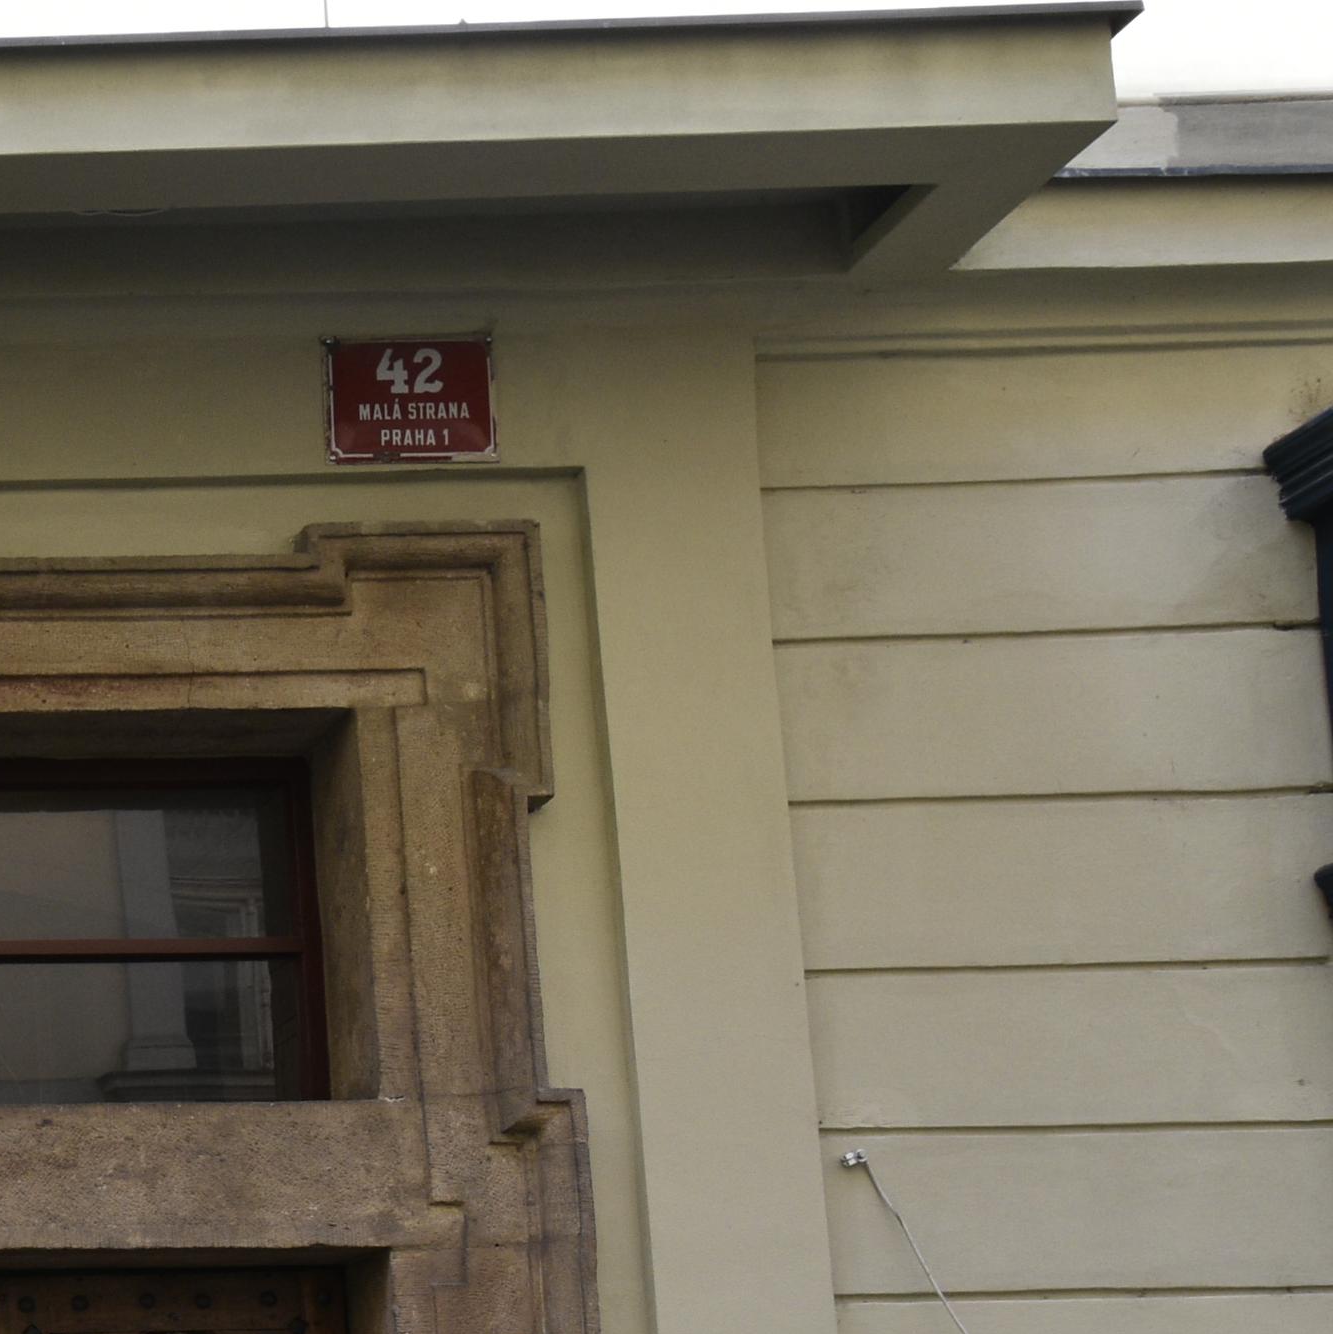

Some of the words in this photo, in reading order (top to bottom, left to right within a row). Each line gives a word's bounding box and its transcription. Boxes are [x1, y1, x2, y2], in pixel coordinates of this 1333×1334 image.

[376, 348, 444, 394] 42
[358, 398, 402, 421] MALÁ
[408, 402, 470, 420] STRANA
[380, 429, 436, 446] PRAHA
[442, 428, 449, 446] 1
